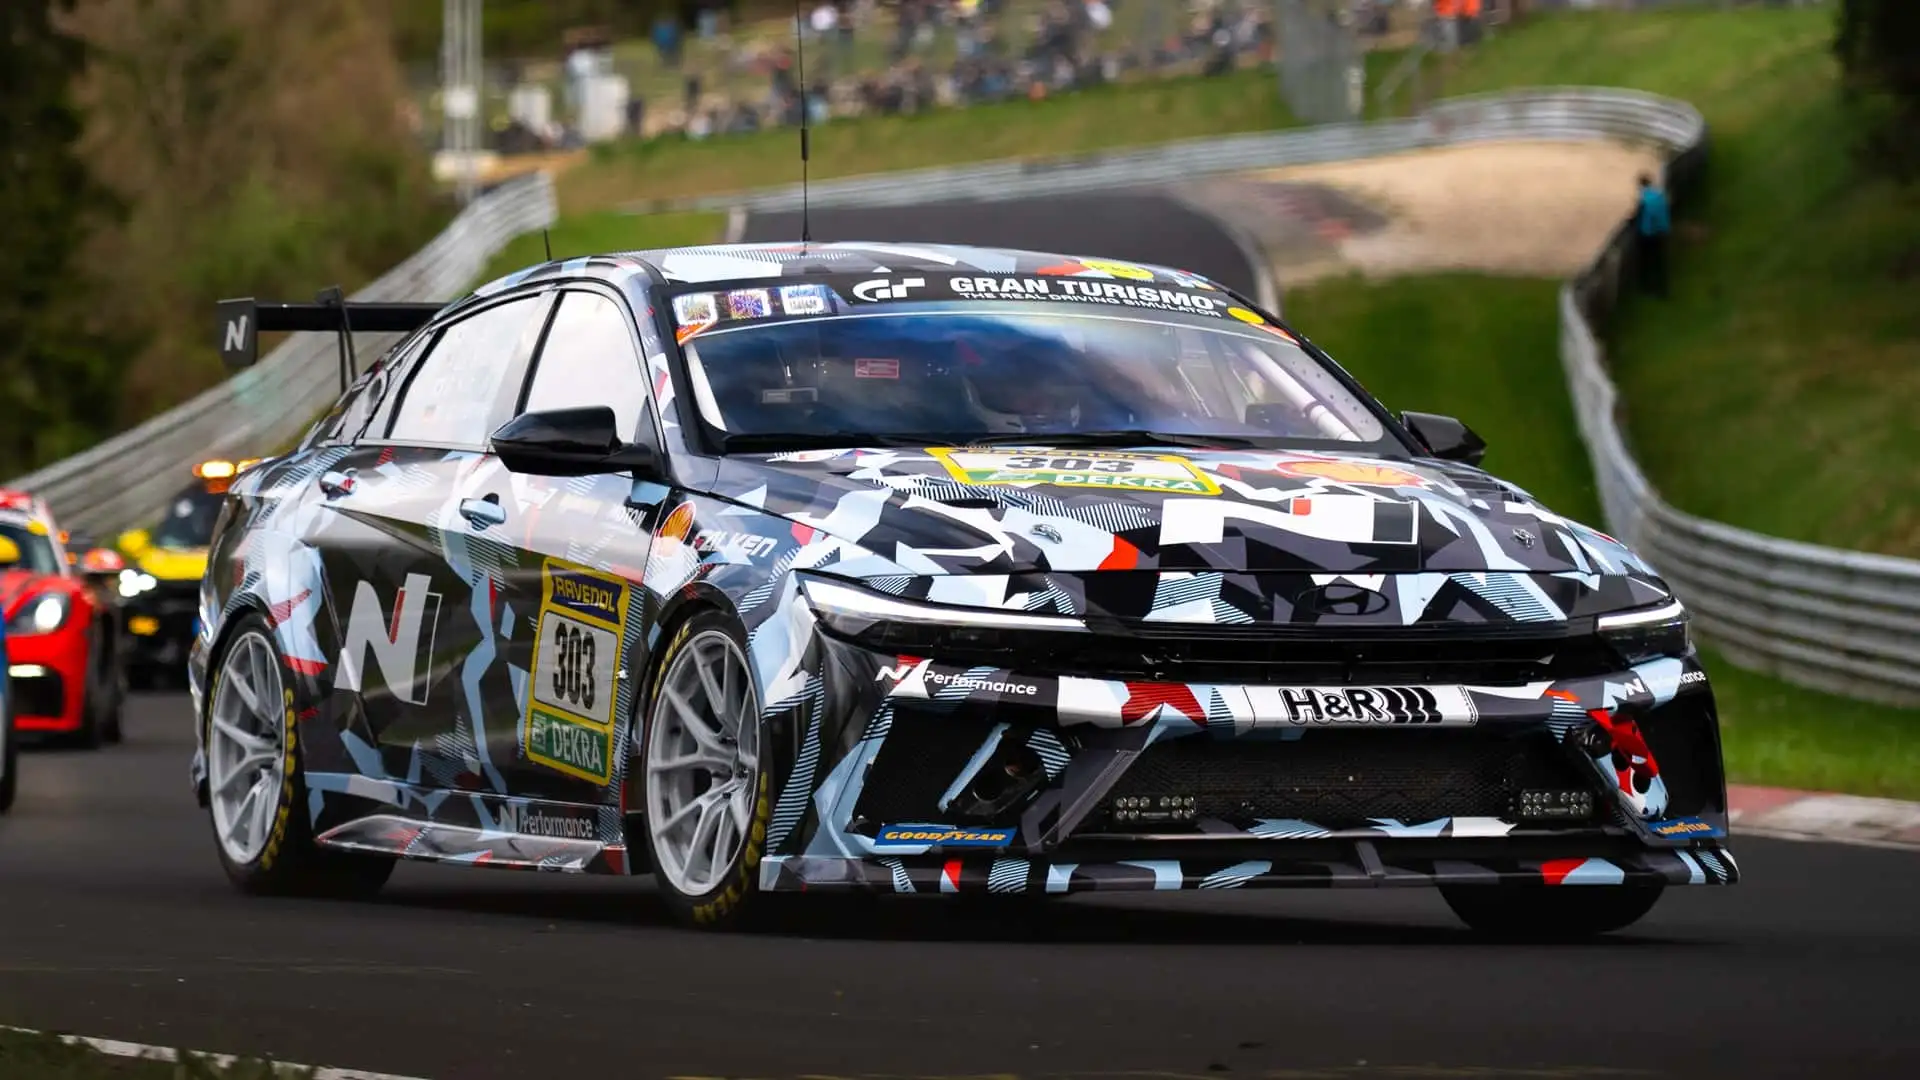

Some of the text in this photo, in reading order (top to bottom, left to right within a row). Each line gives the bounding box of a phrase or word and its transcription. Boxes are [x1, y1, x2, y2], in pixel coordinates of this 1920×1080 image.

[950, 276, 1217, 310] GRAN TURISMO
[960, 292, 1222, 318] THE REAL DRIVING SIMULATOR
[1005, 456, 1135, 473] 303
[1054, 474, 1203, 492] DEKRA
[555, 576, 616, 613] RAVENOL
[552, 621, 597, 710] 303
[924, 670, 1038, 696] Performance
[1279, 687, 1394, 724] H&R
[551, 719, 603, 773] DEKRA
[521, 808, 593, 838] Performance
[884, 830, 1008, 842] GOODYEAR
